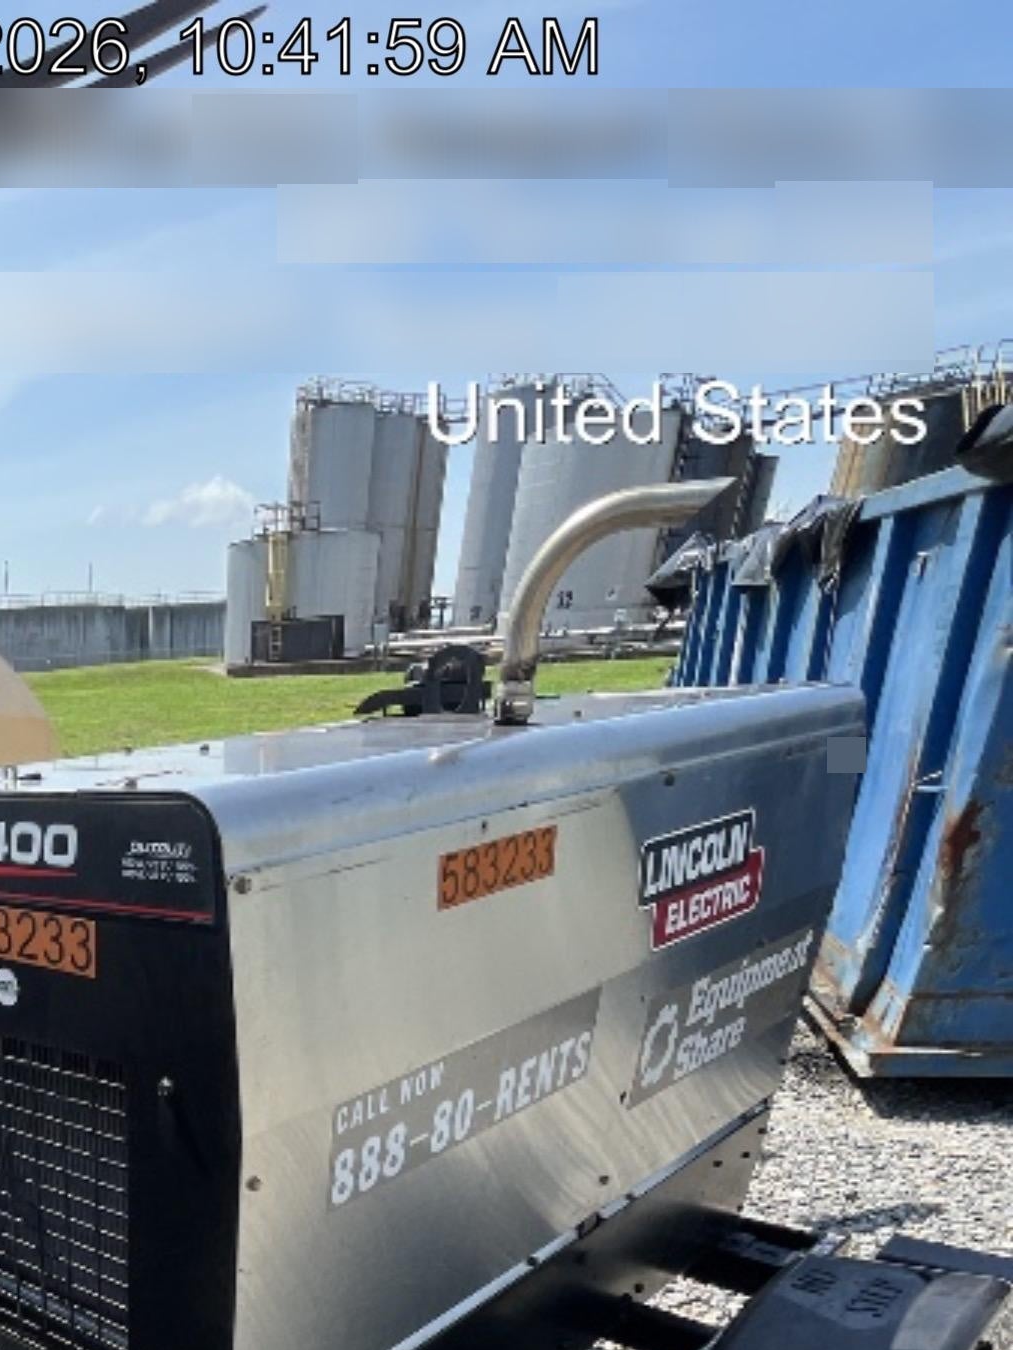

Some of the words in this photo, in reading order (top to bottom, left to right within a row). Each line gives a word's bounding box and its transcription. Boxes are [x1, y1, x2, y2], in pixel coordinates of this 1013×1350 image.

[441, 828, 555, 903] 583233
[644, 821, 748, 897] LINCOLN
[664, 875, 752, 935] ELECTRIC
[686, 929, 814, 1027] Equipment
[673, 1016, 747, 1081] Share
[331, 1031, 593, 1205] 888-80-RENTS
[337, 1088, 389, 1134] CALL
[400, 1061, 445, 1105] NOW
